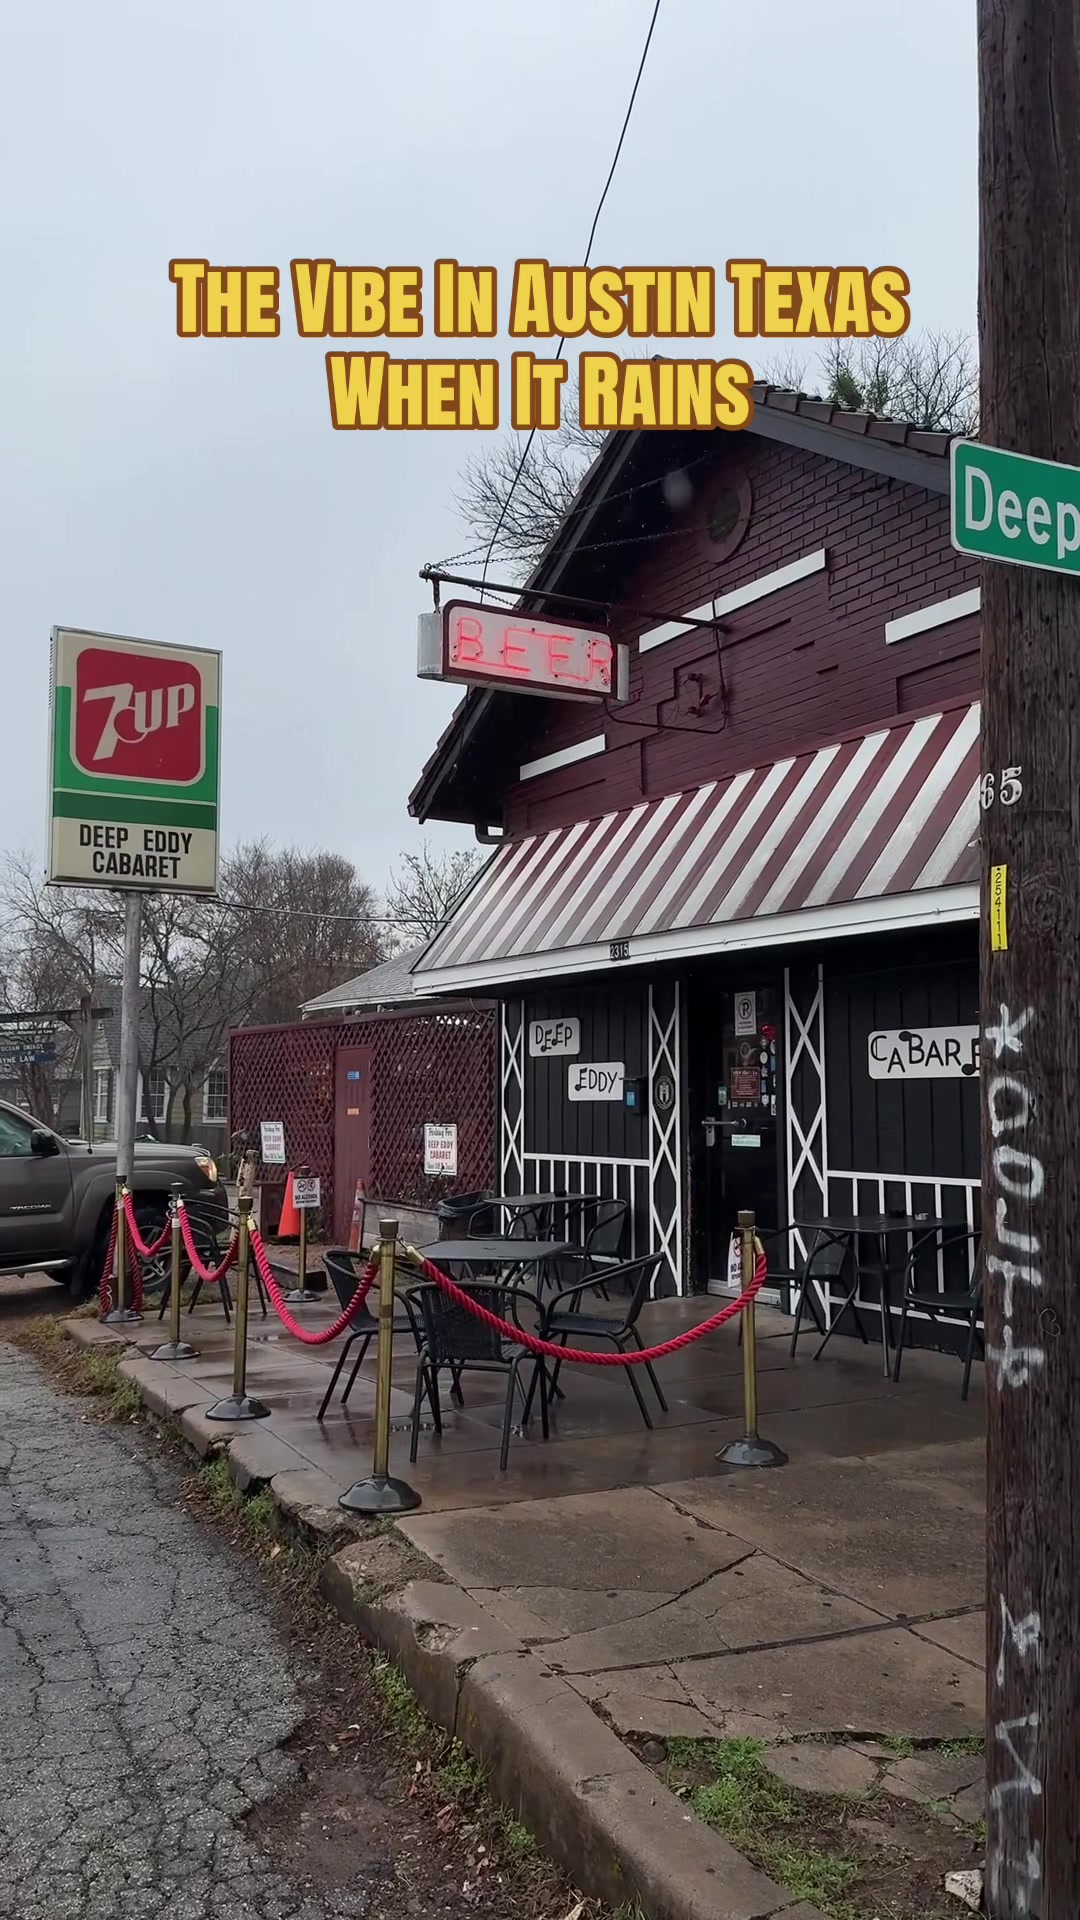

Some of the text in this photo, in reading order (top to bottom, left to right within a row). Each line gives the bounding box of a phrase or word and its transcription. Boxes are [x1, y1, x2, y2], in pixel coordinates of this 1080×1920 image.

[964, 464, 1080, 561] Deep
[454, 617, 614, 684] BEER
[980, 766, 1023, 810] 65
[79, 824, 193, 854] DEEP EDDY
[92, 851, 181, 879] CABARET
[609, 943, 629, 959] 2315
[535, 1022, 572, 1053] DEEP
[20, 1055, 36, 1063] LAW
[574, 1067, 618, 1094] EDDY
[430, 1150, 452, 1159] CABARET
[441, 1140, 453, 1149] EDDY
